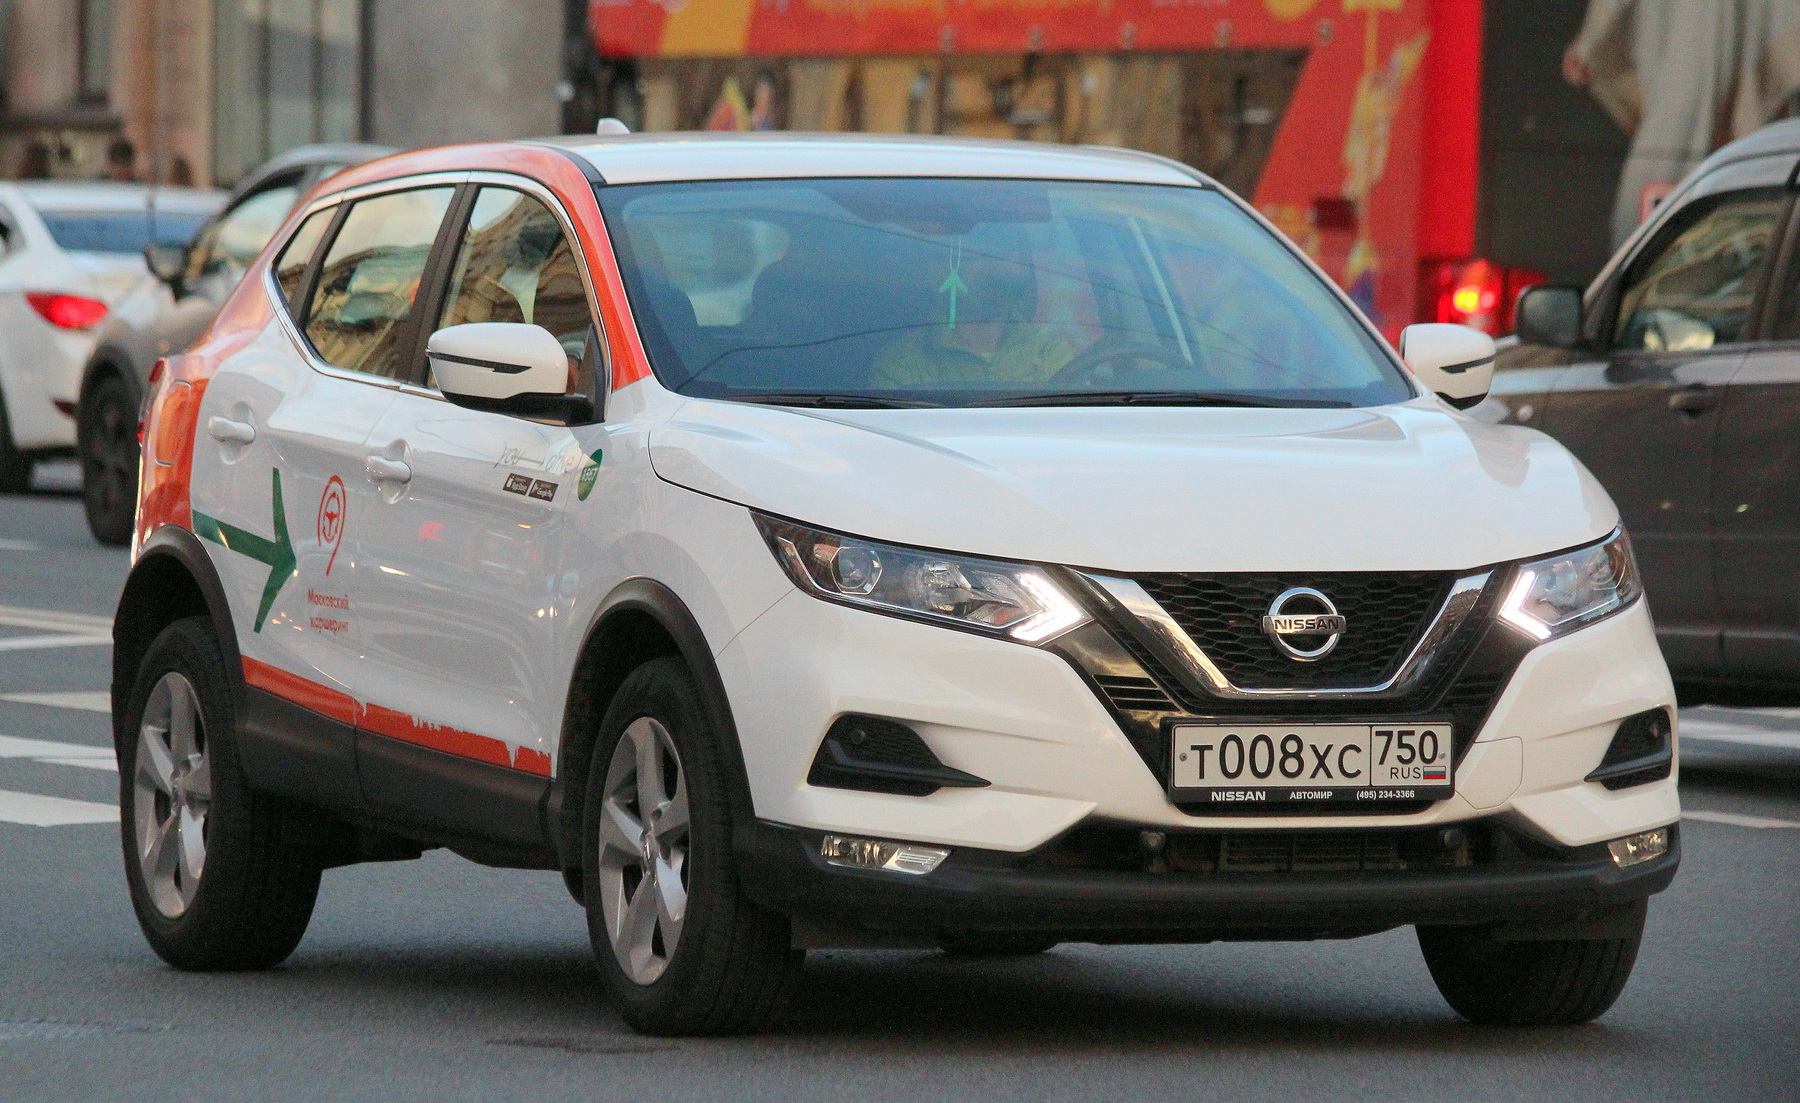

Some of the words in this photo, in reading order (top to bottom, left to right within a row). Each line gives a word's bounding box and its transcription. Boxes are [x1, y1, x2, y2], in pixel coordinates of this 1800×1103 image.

[1274, 618, 1339, 630] NISSAN
[1375, 730, 1438, 766] 750
[1390, 766, 1421, 780] RUS
[1211, 790, 1266, 801] NISSAN
[1289, 790, 1333, 800] АВТОМИР
[1356, 790, 1377, 801] (495)
[1378, 789, 1415, 800] 234-3366
